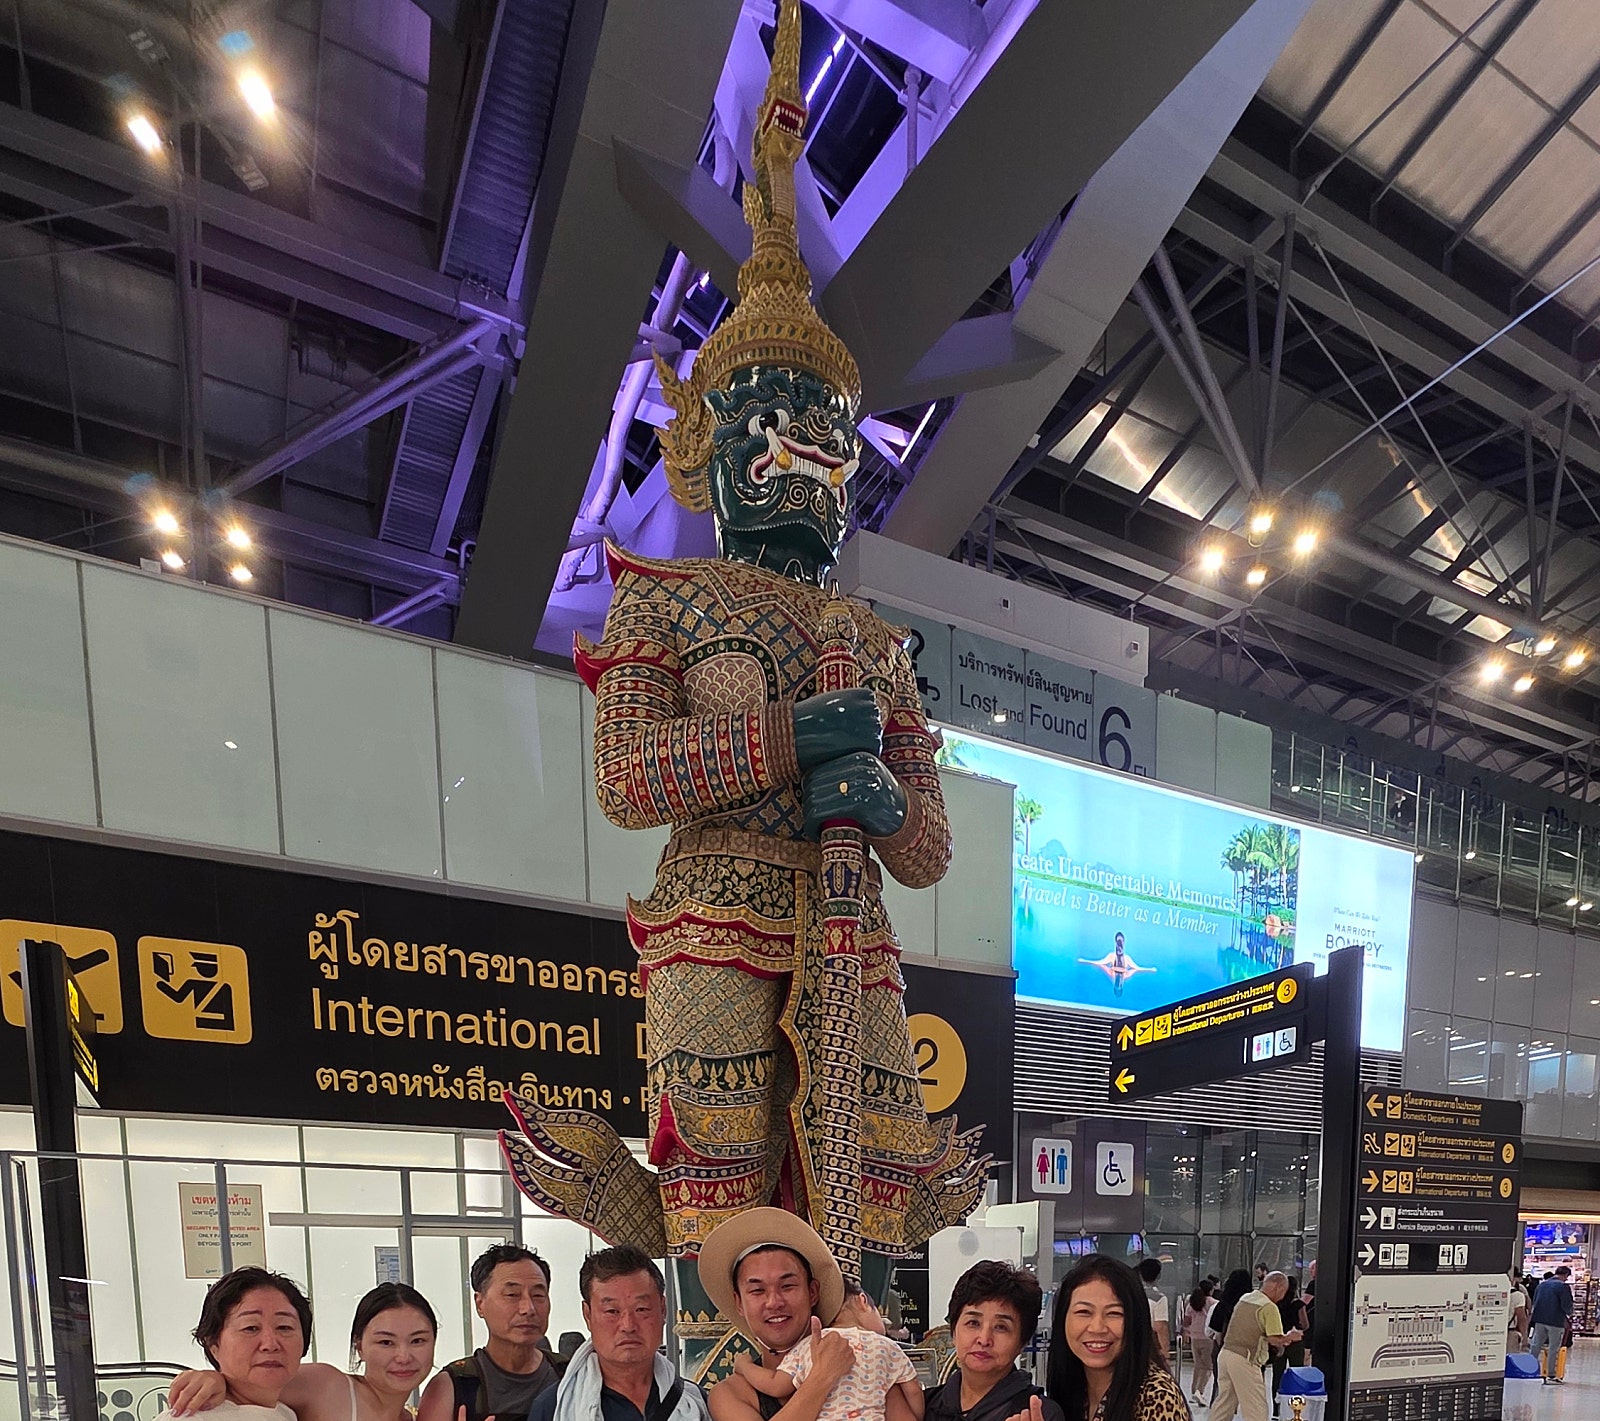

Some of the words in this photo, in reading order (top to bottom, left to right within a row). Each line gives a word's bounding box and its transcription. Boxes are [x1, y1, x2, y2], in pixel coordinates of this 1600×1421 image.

[960, 684, 998, 714] Lost
[1002, 706, 1024, 723] and
[1030, 703, 1087, 741] Found
[1100, 706, 1132, 772] 6
[1015, 853, 1054, 873] reate
[1058, 856, 1164, 896] Unforgettable
[1019, 878, 1067, 907] Travel
[1070, 895, 1082, 911] is
[1085, 892, 1131, 919] Better
[1134, 908, 1149, 923] as
[1152, 911, 1161, 925] a
[1334, 922, 1376, 939] MARRIOTT
[1283, 984, 1291, 996] 3
[312, 987, 601, 1056] International
[1172, 1018, 1209, 1036] International
[1210, 1009, 1245, 1026] Departures
[913, 1037, 939, 1087] 2
[1403, 1111, 1427, 1122] Domestic
[1427, 1113, 1454, 1124] Departures
[1505, 1148, 1511, 1159] 2
[1503, 1182, 1509, 1193] 3
